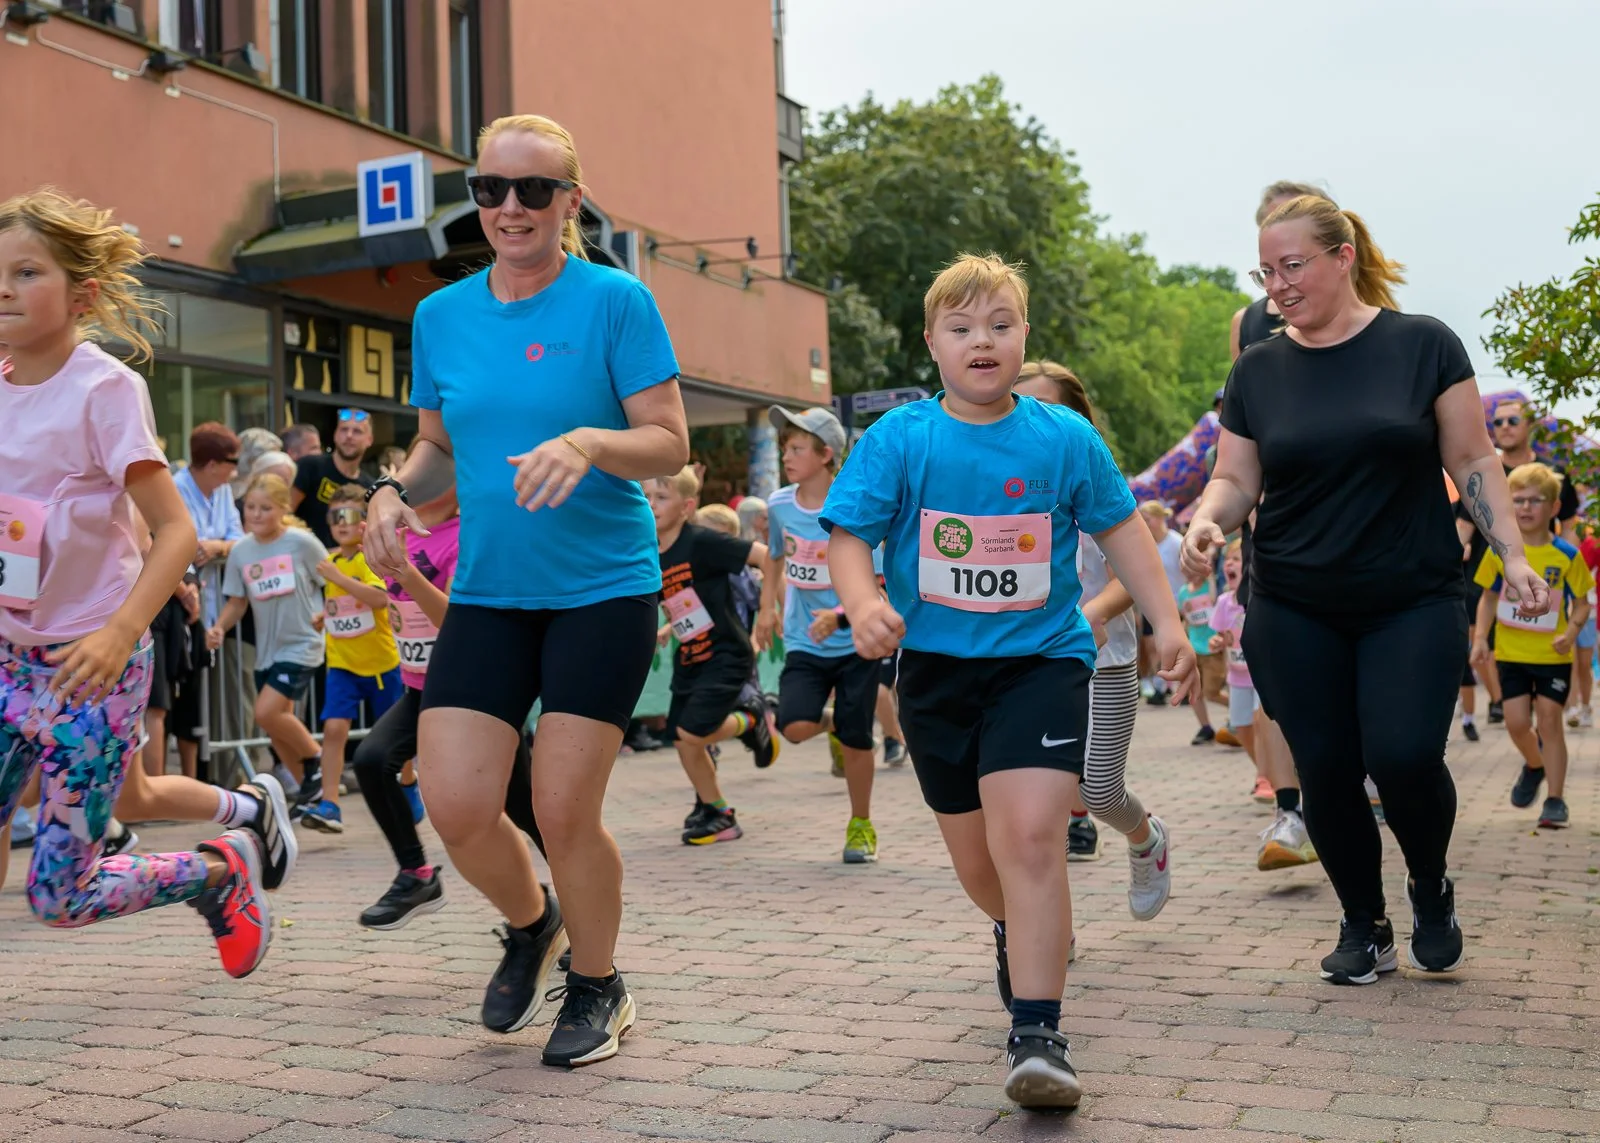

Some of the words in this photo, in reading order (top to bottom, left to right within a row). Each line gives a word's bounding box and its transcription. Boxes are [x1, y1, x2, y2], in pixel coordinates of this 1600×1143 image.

[1029, 480, 1049, 489] FUB
[981, 536, 1015, 545] Sörmlands
[984, 545, 1015, 554] Sparbank
[950, 567, 1019, 597] 1108
[333, 617, 362, 631] 1065
